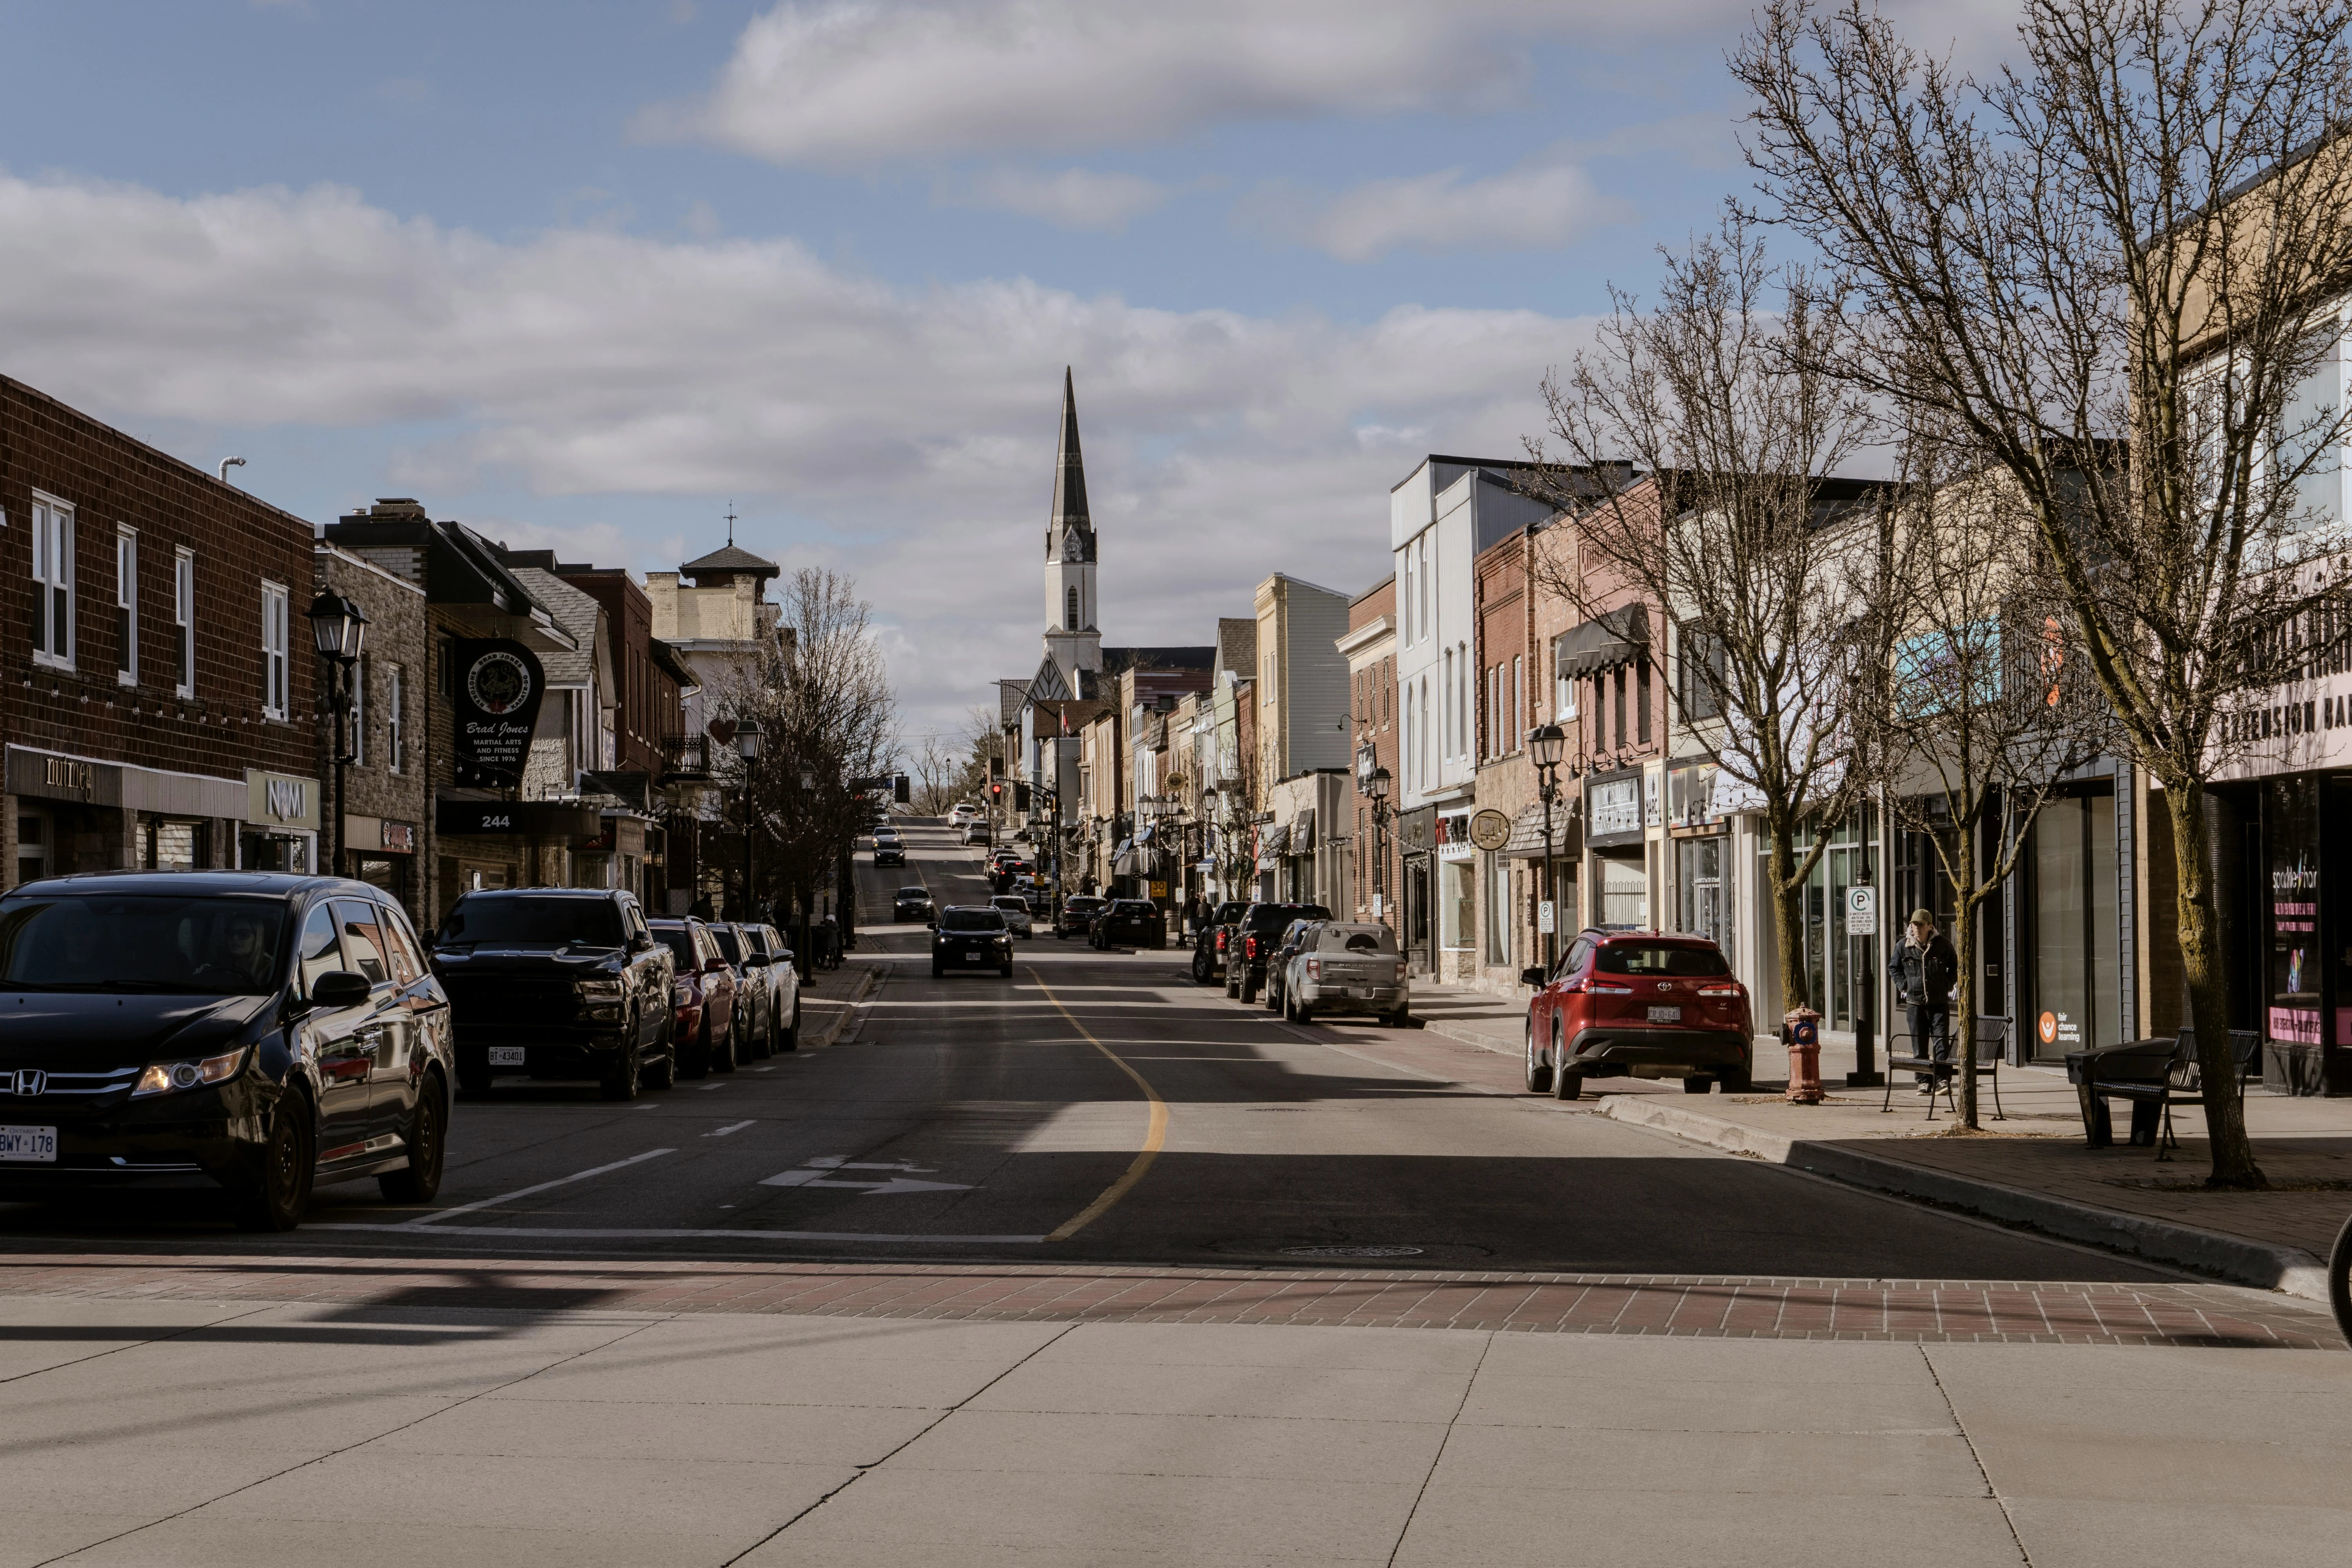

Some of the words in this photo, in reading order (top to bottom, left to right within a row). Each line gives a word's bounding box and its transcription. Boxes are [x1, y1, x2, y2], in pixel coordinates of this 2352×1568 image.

[478, 653, 497, 666] BRAD
[500, 653, 523, 668] JONES
[470, 671, 485, 708] SHOTOKAN
[511, 675, 528, 710] KARATE-DO
[466, 722, 496, 733] Brad
[498, 722, 529, 737] Jones
[47, 756, 91, 802] nutmeg
[482, 816, 510, 827] 244
[1594, 808, 1637, 832] CONVENIENCE
[2273, 866, 2297, 894] sparkle
[2303, 865, 2317, 888] hair
[1857, 895, 1865, 906] P
[1649, 1010, 1664, 1019] CRJD
[1668, 1011, 1679, 1019] 640
[2058, 1013, 2067, 1021] fair
[2058, 1022, 2077, 1031] chance
[2059, 1032, 2080, 1042] learning
[490, 1051, 498, 1061] BT
[502, 1051, 523, 1061] 43401
[31, 1135, 53, 1152] 178
